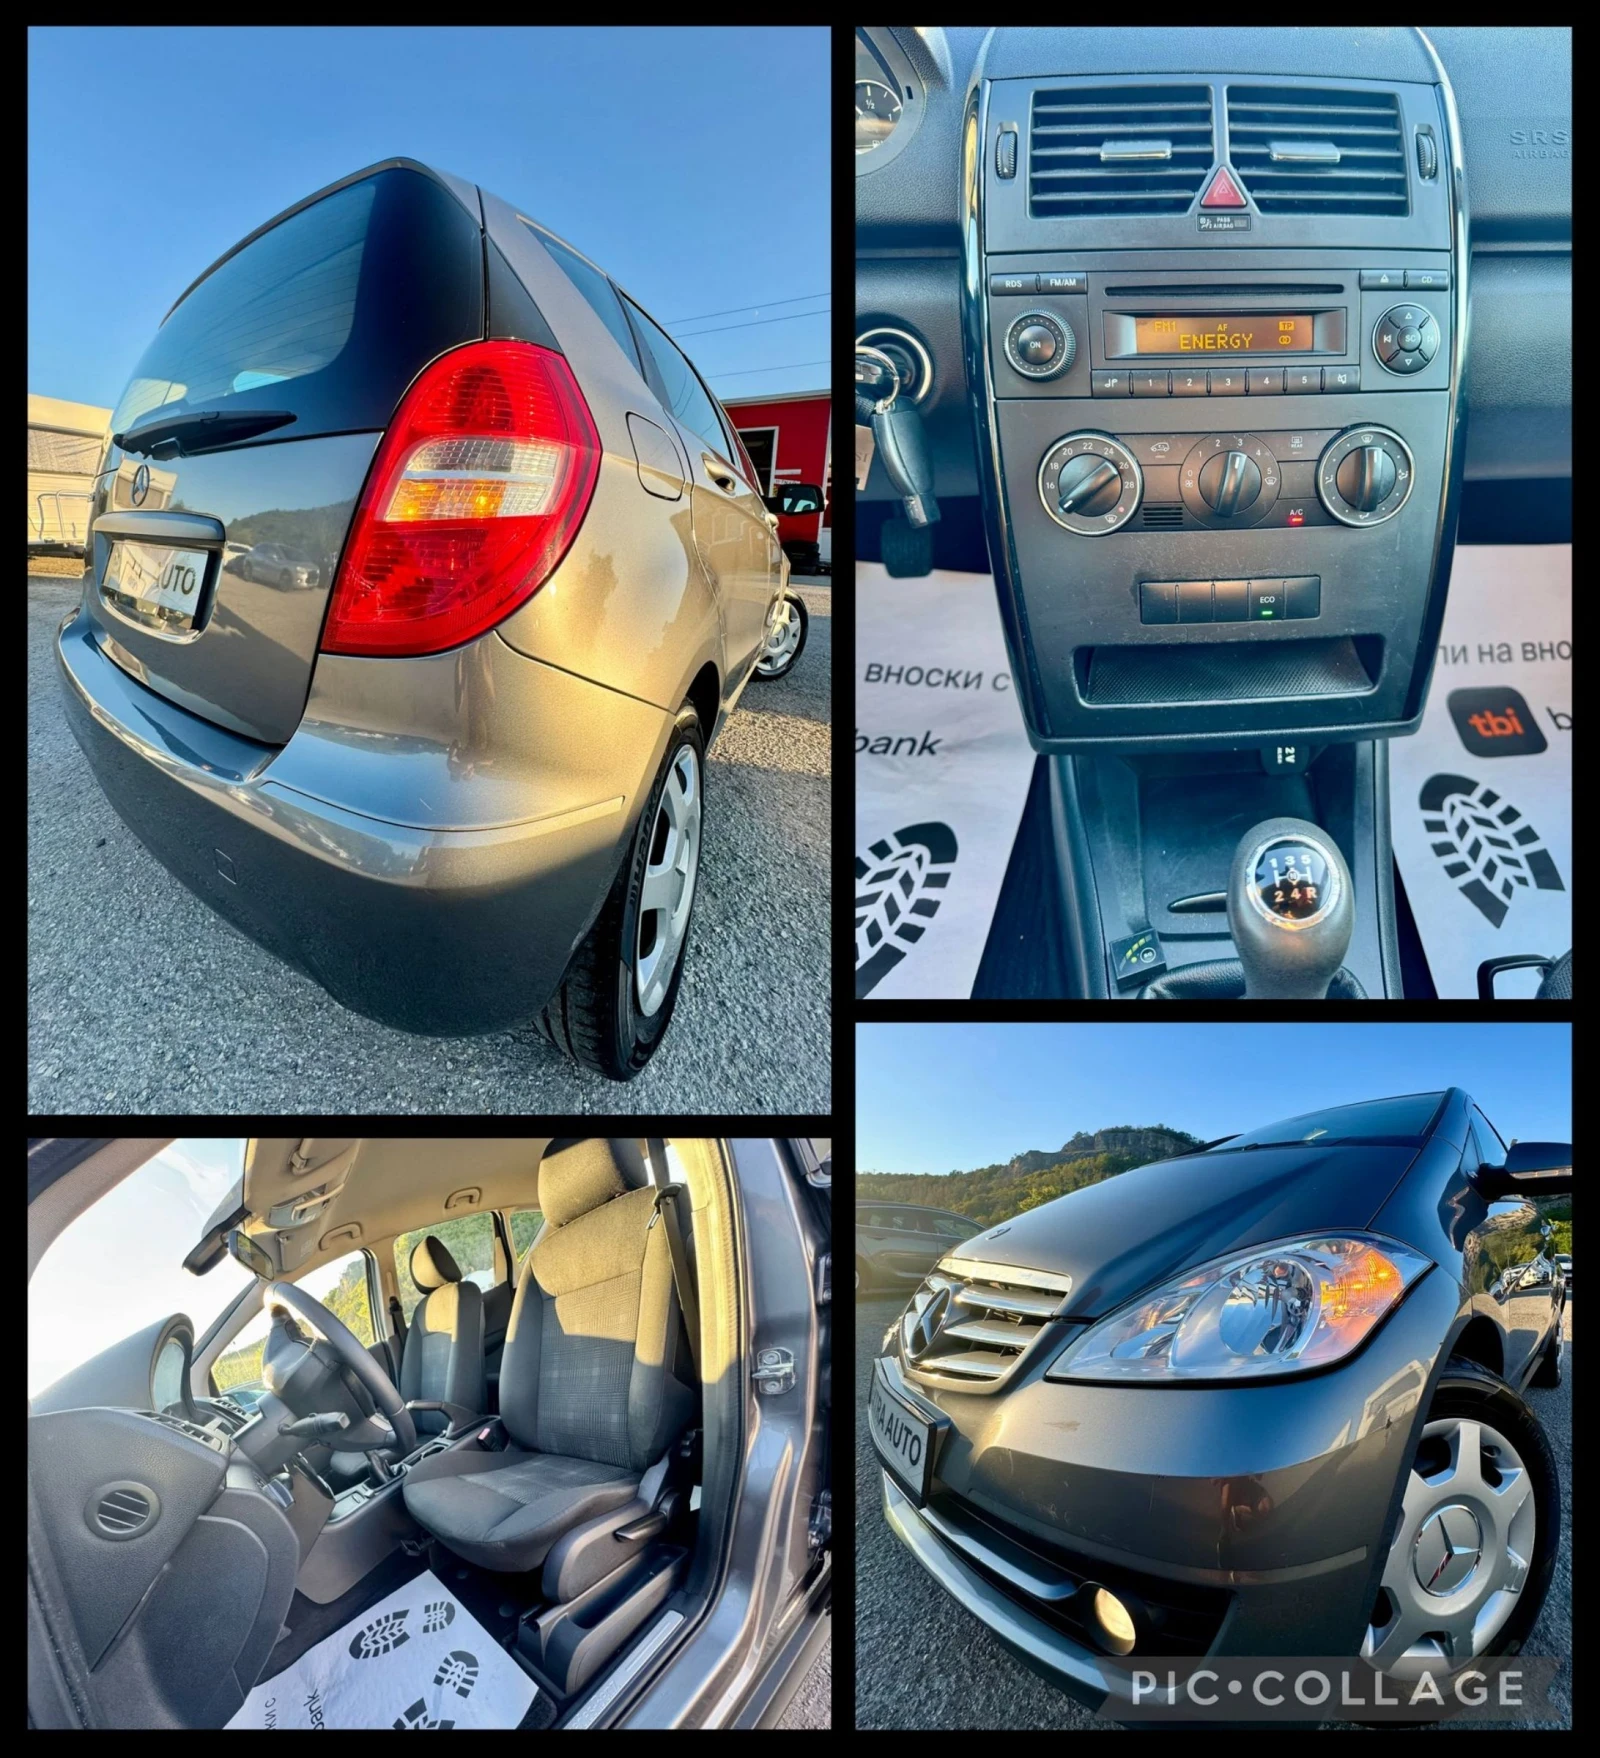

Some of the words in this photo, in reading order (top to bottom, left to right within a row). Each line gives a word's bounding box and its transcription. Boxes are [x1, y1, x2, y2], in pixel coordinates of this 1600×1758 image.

[1510, 130, 1569, 145] SRS
[1512, 150, 1570, 159] AIRBAG
[1005, 280, 1023, 288] RDS
[1049, 278, 1077, 287] FM/AM
[1421, 276, 1433, 284] CD
[1154, 322, 1177, 333] FM1
[1217, 323, 1229, 332] AF
[1281, 321, 1295, 330] TP
[1180, 333, 1253, 350] ENERGY
[1404, 334, 1417, 344] SC
[1029, 341, 1042, 349] ON
[1186, 379, 1193, 387] 2
[1224, 378, 1231, 386] 3
[1263, 377, 1270, 385] 4
[1301, 376, 1308, 384] 5
[1082, 442, 1093, 450] 22
[1103, 447, 1114, 455] 24
[1050, 462, 1059, 470] 18
[1046, 481, 1055, 489] 16
[1124, 481, 1135, 489] 28
[1289, 508, 1304, 516] A/C
[158, 563, 196, 595] UTO
[1259, 596, 1276, 604] ECO
[1477, 642, 1514, 664] на
[1467, 706, 1525, 738] tbi
[1269, 857, 1278, 868] 1
[1284, 855, 1296, 866] 3
[1301, 854, 1311, 866] 5
[1274, 890, 1285, 903] 2
[1290, 888, 1301, 900] 4
[1305, 886, 1318, 899] R
[884, 1412, 923, 1467] AUTO
